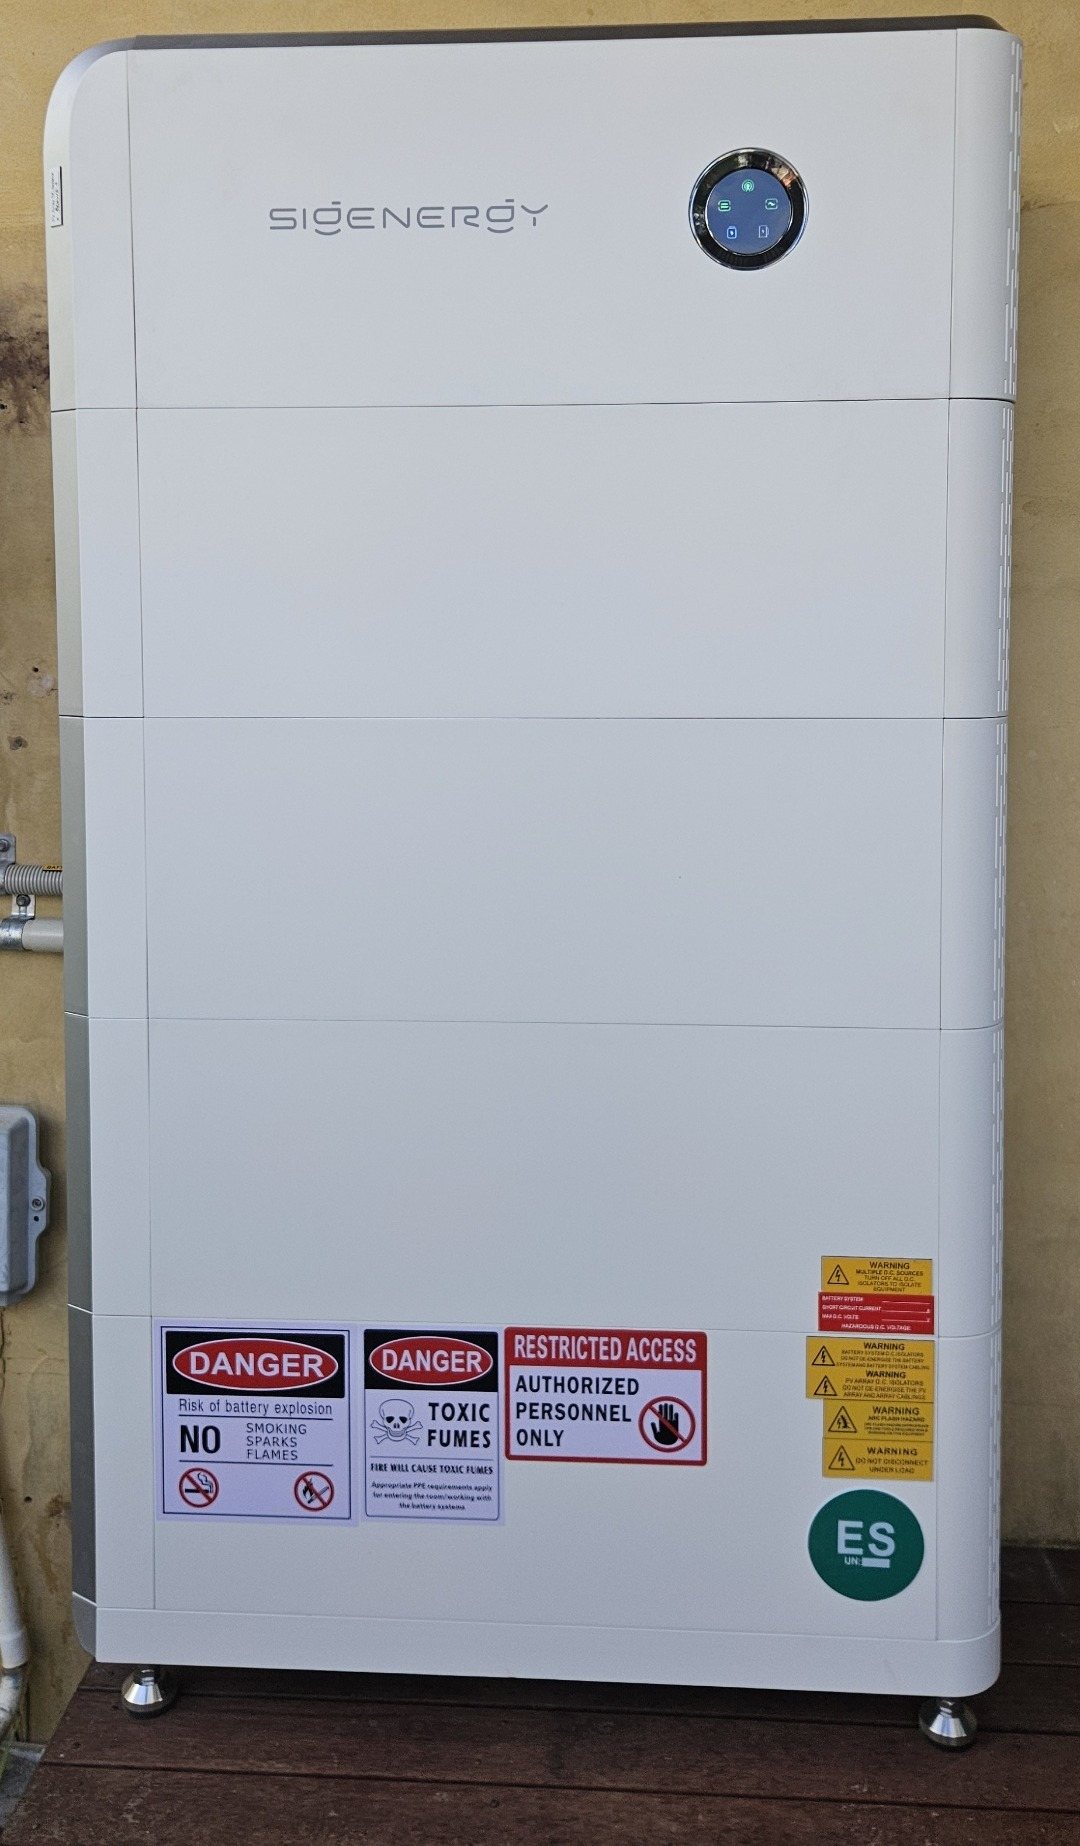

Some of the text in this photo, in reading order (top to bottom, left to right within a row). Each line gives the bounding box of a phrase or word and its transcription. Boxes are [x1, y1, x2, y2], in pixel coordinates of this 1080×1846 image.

[870, 1262, 910, 1270] WARNING
[514, 1334, 697, 1363] RESTRICTED ACCESS
[864, 1342, 905, 1350] WARNING
[189, 1352, 325, 1378] DANGER
[382, 1348, 483, 1374] DANGER
[866, 1370, 906, 1378] WARNING
[515, 1375, 640, 1396] AUTHORIZED
[179, 1398, 333, 1416] Risk of battery explosion
[428, 1402, 490, 1422] TOXIC
[516, 1402, 632, 1422] PERSONNEL
[872, 1406, 920, 1415] WARNING
[246, 1422, 307, 1435] SMOKING
[180, 1424, 221, 1454] NO
[246, 1436, 298, 1448] SPARKS
[427, 1428, 491, 1449] FUMES
[516, 1429, 564, 1447] ONLY
[246, 1449, 298, 1460] FLAMES
[866, 1446, 918, 1456] WARNING
[370, 1463, 494, 1474] FIRE WILL CAUSE TOXIC FUMES
[372, 1481, 412, 1490] Appropriate
[427, 1483, 472, 1491] requirements
[837, 1520, 896, 1557] ES
